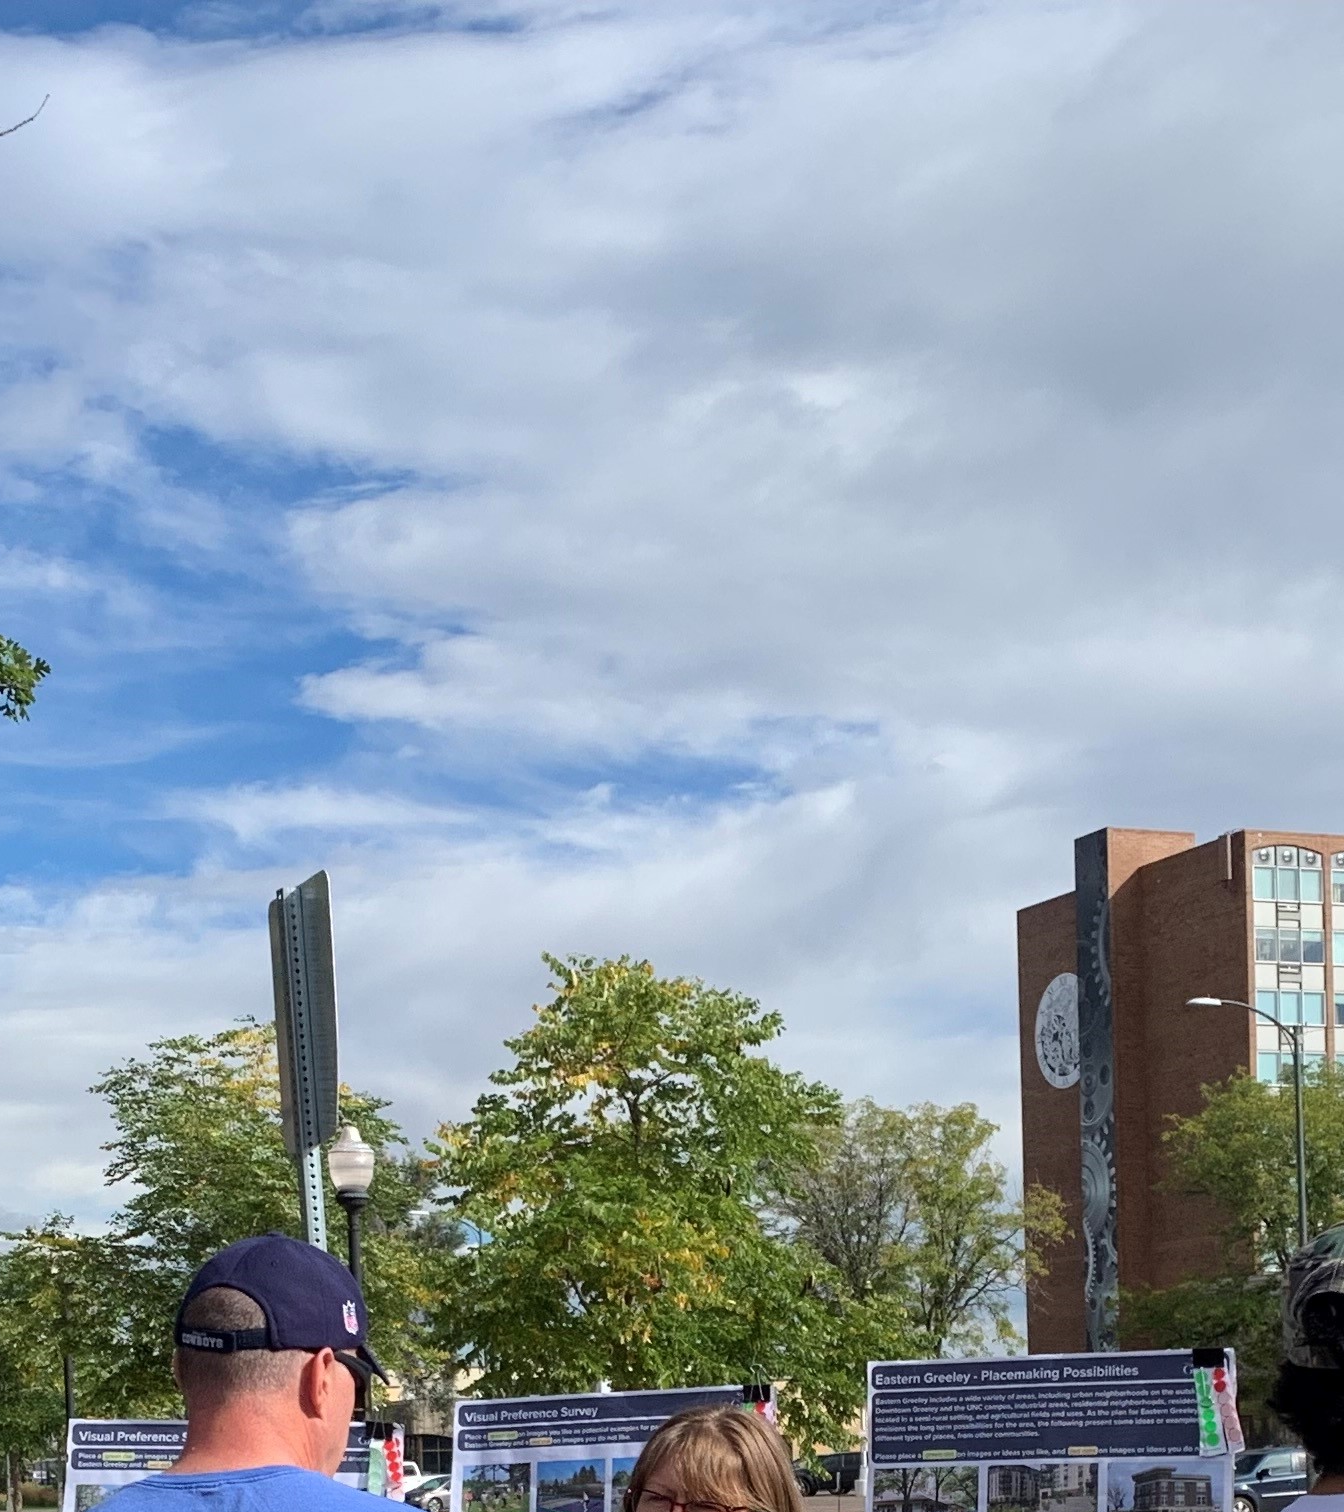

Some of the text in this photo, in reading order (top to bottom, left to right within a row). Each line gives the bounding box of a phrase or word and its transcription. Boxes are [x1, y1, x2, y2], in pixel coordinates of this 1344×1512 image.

[182, 1332, 224, 1349] COWBOYS
[875, 1373, 920, 1386] Eastern
[924, 1371, 971, 1384] Greeley
[981, 1367, 1060, 1381] Placemaking
[1063, 1365, 1139, 1378] Possibilities
[465, 1407, 598, 1422] Visual Preference Survey
[79, 1431, 114, 1442] Visual
[117, 1431, 179, 1442] Preference
